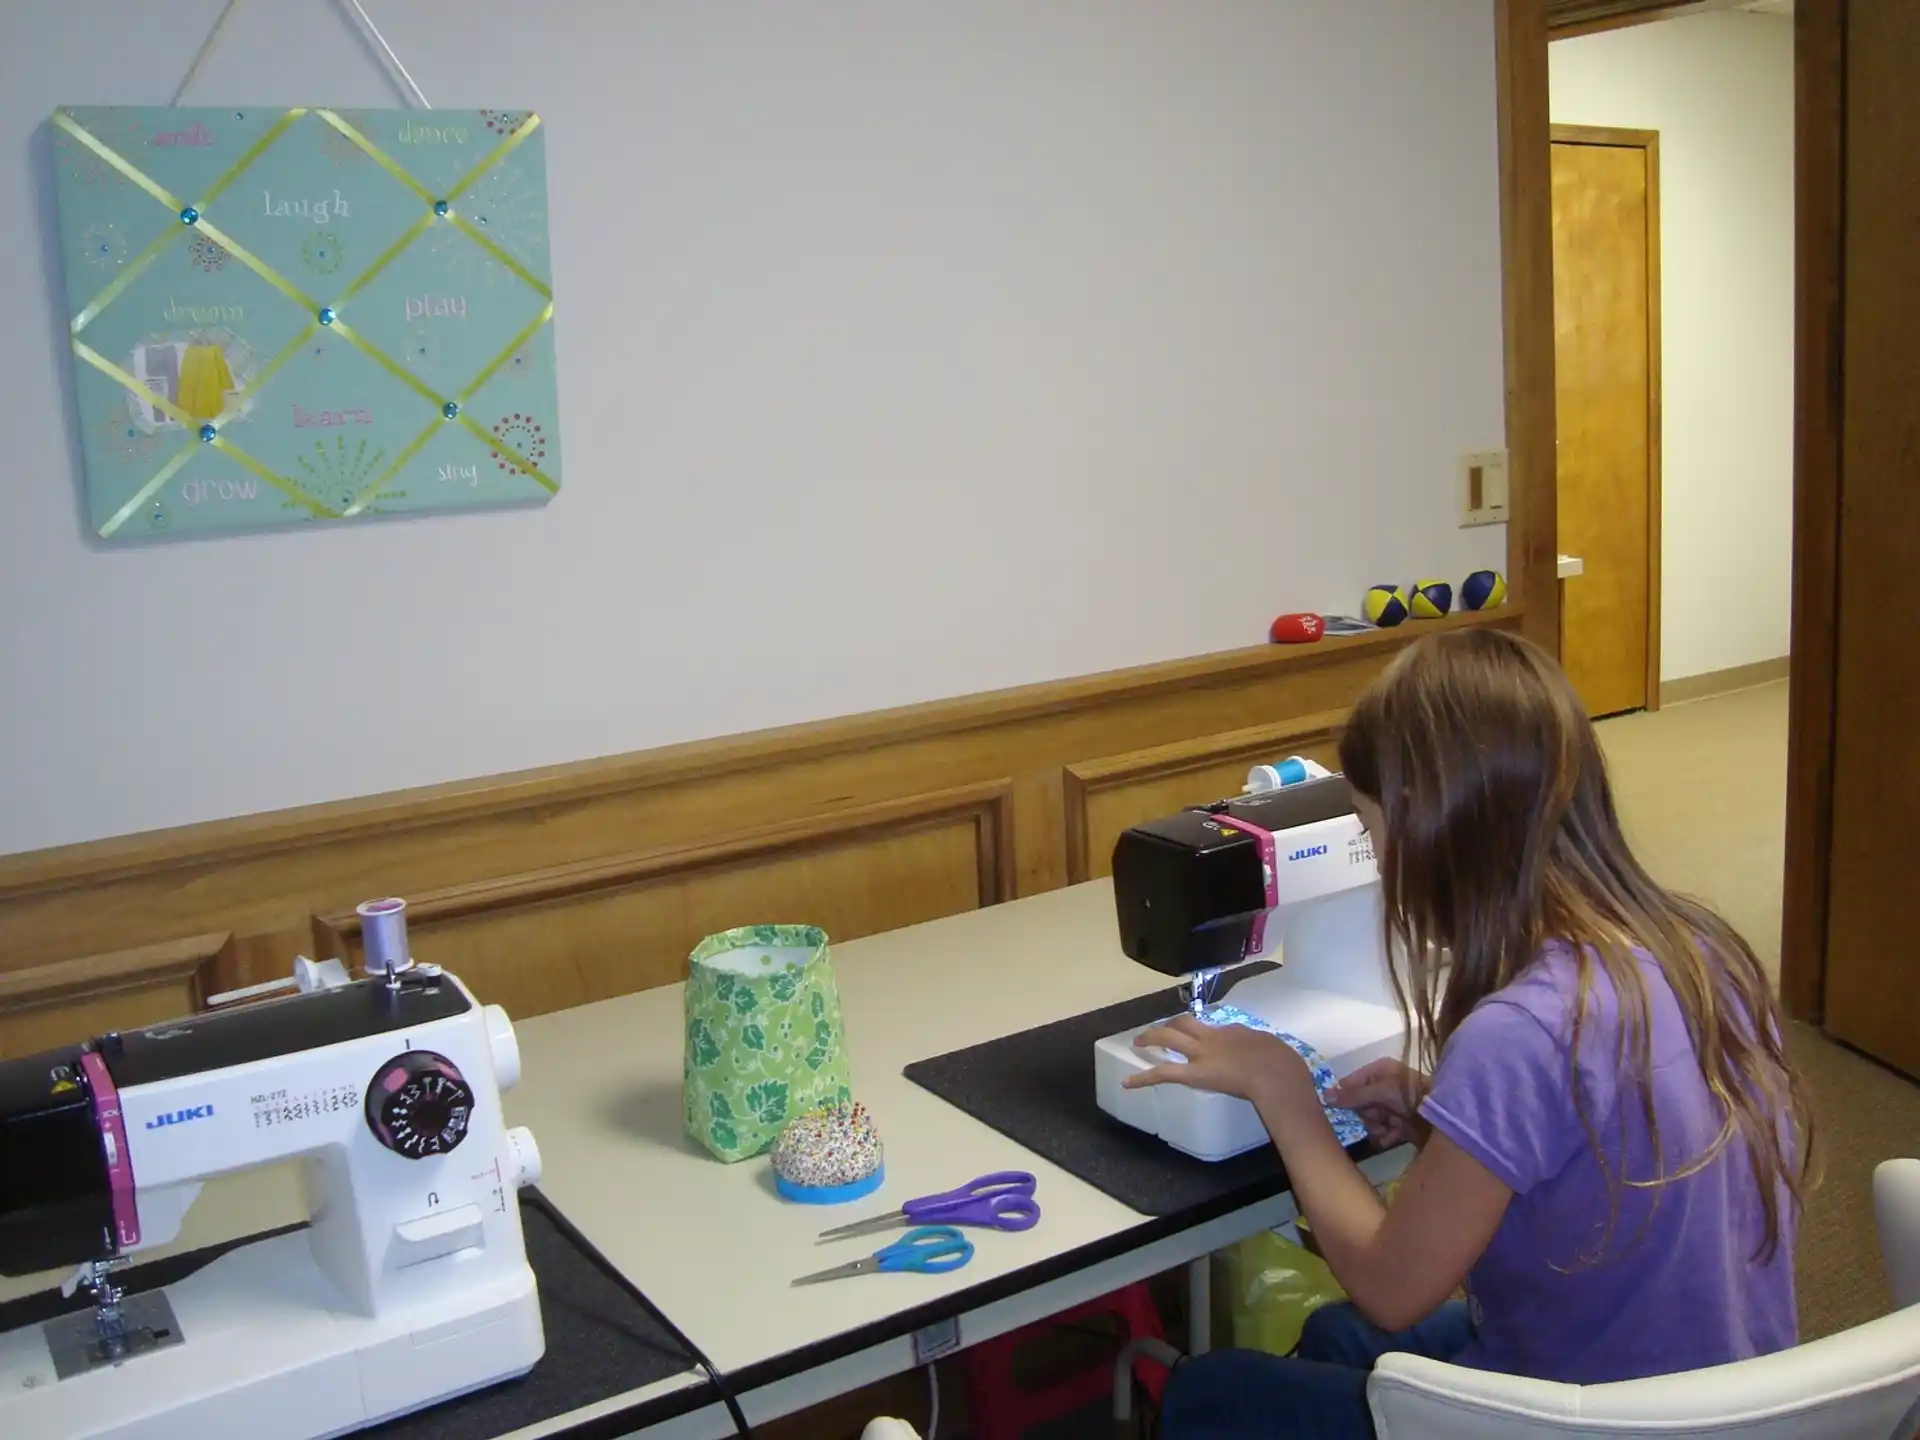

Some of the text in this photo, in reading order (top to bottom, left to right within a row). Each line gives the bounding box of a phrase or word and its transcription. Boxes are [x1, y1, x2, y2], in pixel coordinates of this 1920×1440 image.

[398, 119, 468, 145] dance
[262, 189, 352, 224] laugh
[405, 294, 467, 322] play
[181, 478, 258, 506] grow
[1288, 844, 1328, 862] JUKI
[145, 1104, 214, 1129] JUKI
